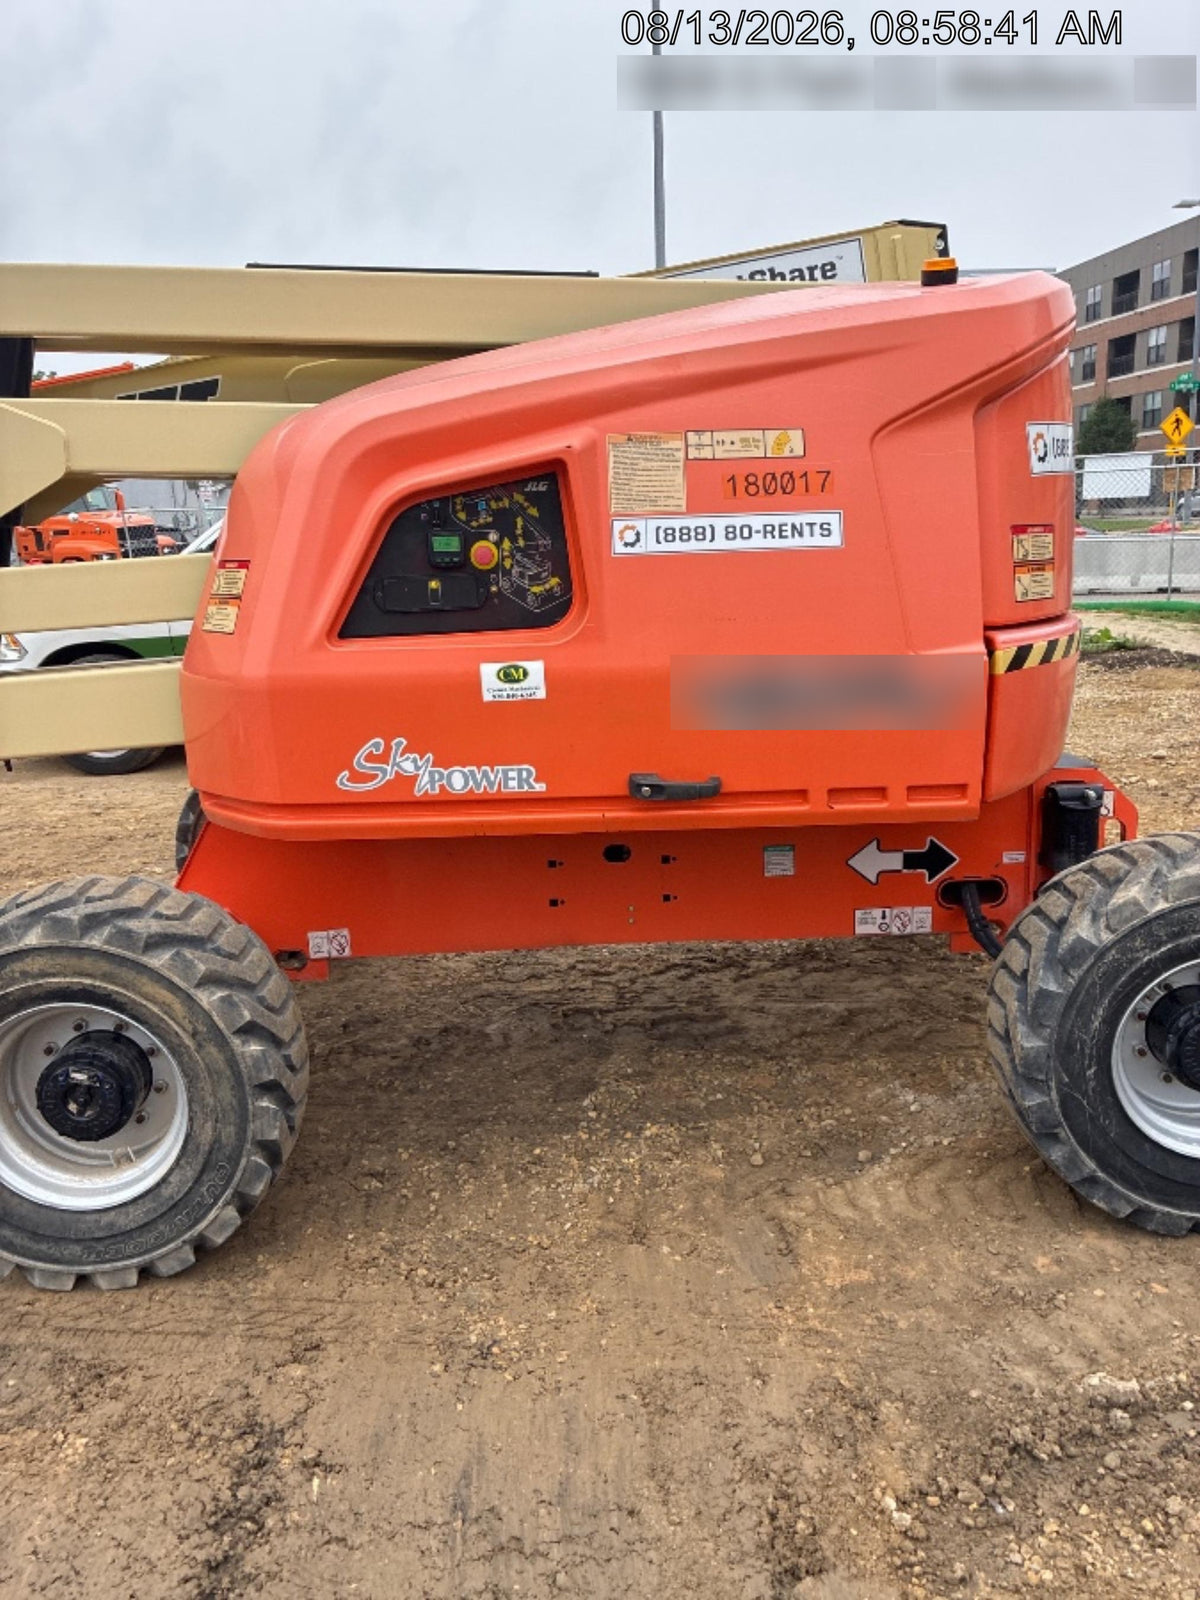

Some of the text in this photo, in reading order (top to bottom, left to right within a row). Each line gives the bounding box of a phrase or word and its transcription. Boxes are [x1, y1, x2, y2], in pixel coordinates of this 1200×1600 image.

[727, 470, 831, 497] 180017
[655, 521, 832, 544] (888) 80-RENTS
[498, 668, 524, 681] CM
